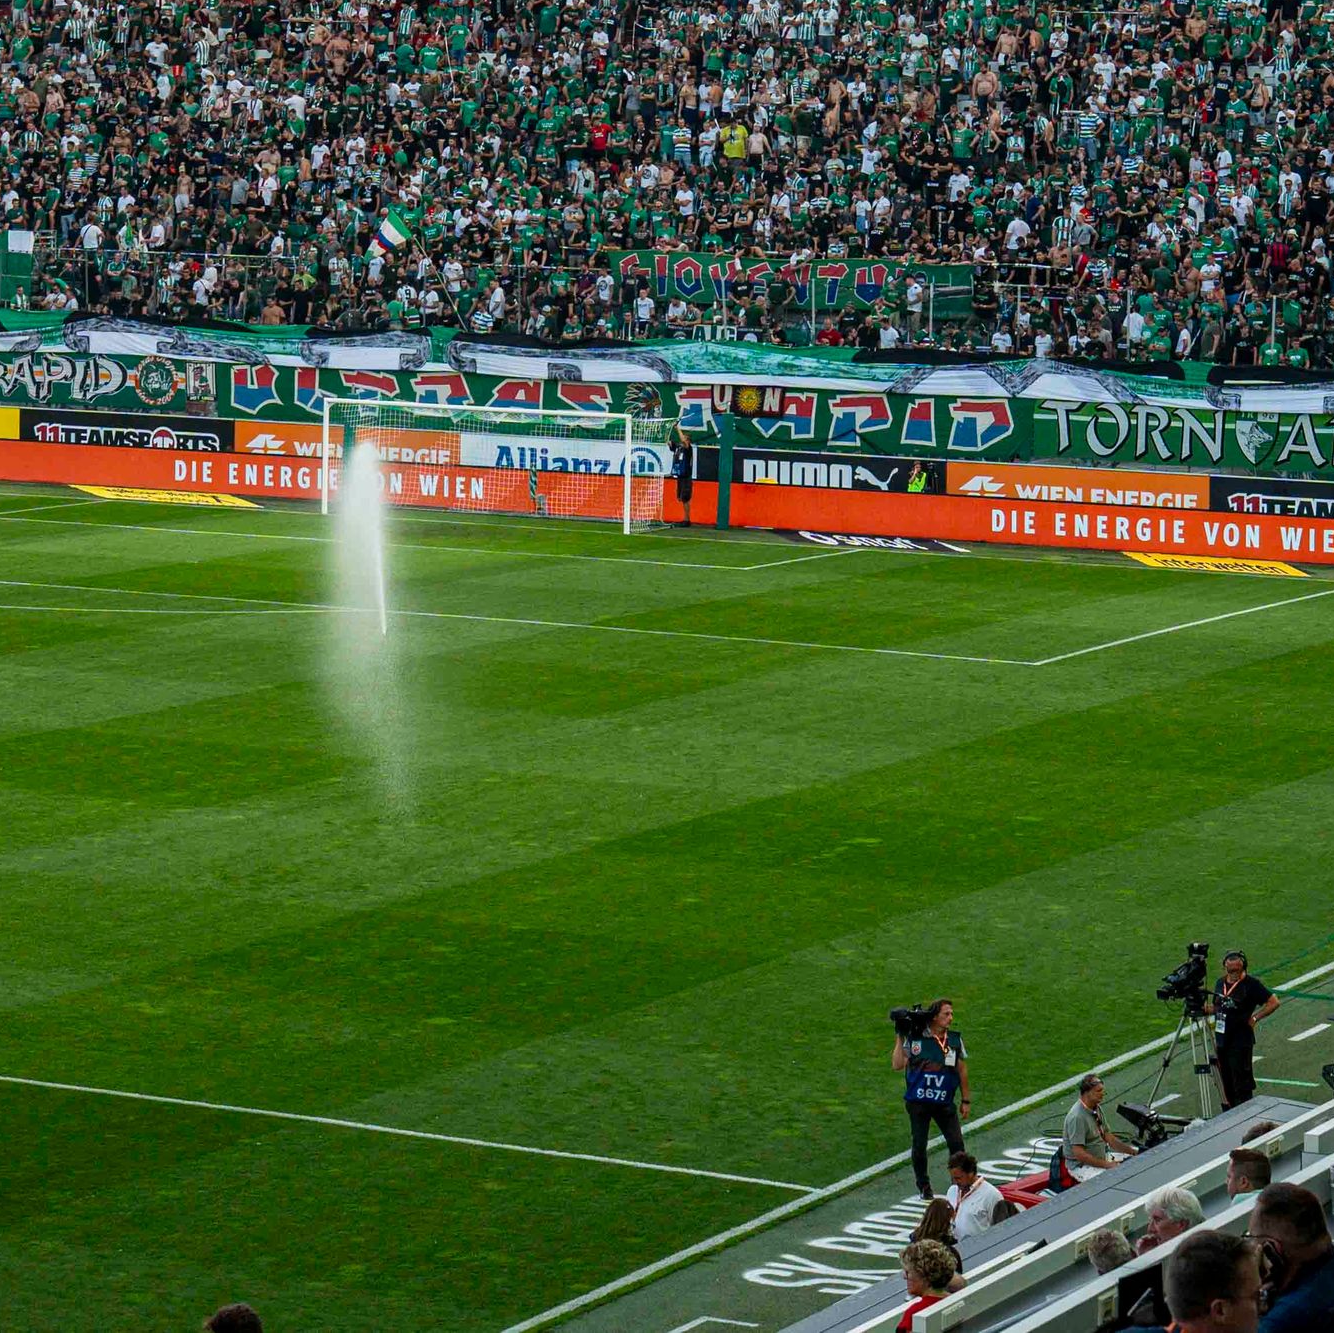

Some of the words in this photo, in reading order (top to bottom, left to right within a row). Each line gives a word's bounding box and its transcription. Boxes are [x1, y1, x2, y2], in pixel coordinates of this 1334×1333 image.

[174, 459, 213, 483] DIE
[228, 462, 338, 492] ENERGIE
[419, 475, 484, 500] WIEN
[991, 509, 1036, 534] DIE
[1055, 512, 1185, 544] ENERGIE
[1203, 521, 1260, 548] VON
[924, 1073, 945, 1087] TV
